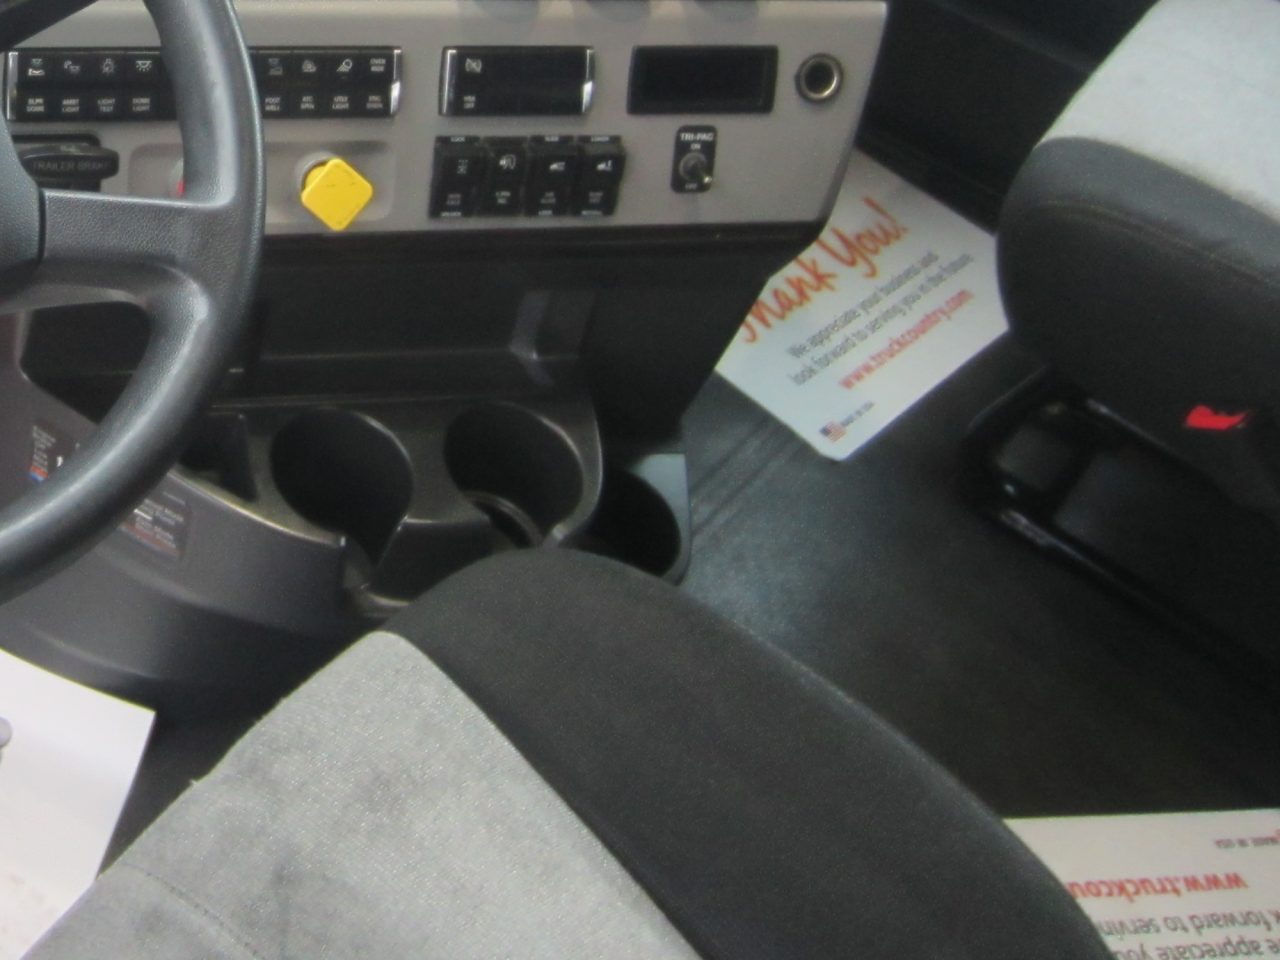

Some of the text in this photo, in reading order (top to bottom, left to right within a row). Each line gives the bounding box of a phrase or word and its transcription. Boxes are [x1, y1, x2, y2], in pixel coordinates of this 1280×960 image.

[680, 132, 714, 141] TRI-PAC
[816, 197, 909, 278] You!
[1163, 915, 1189, 933] to
[1189, 909, 1273, 936] forward
